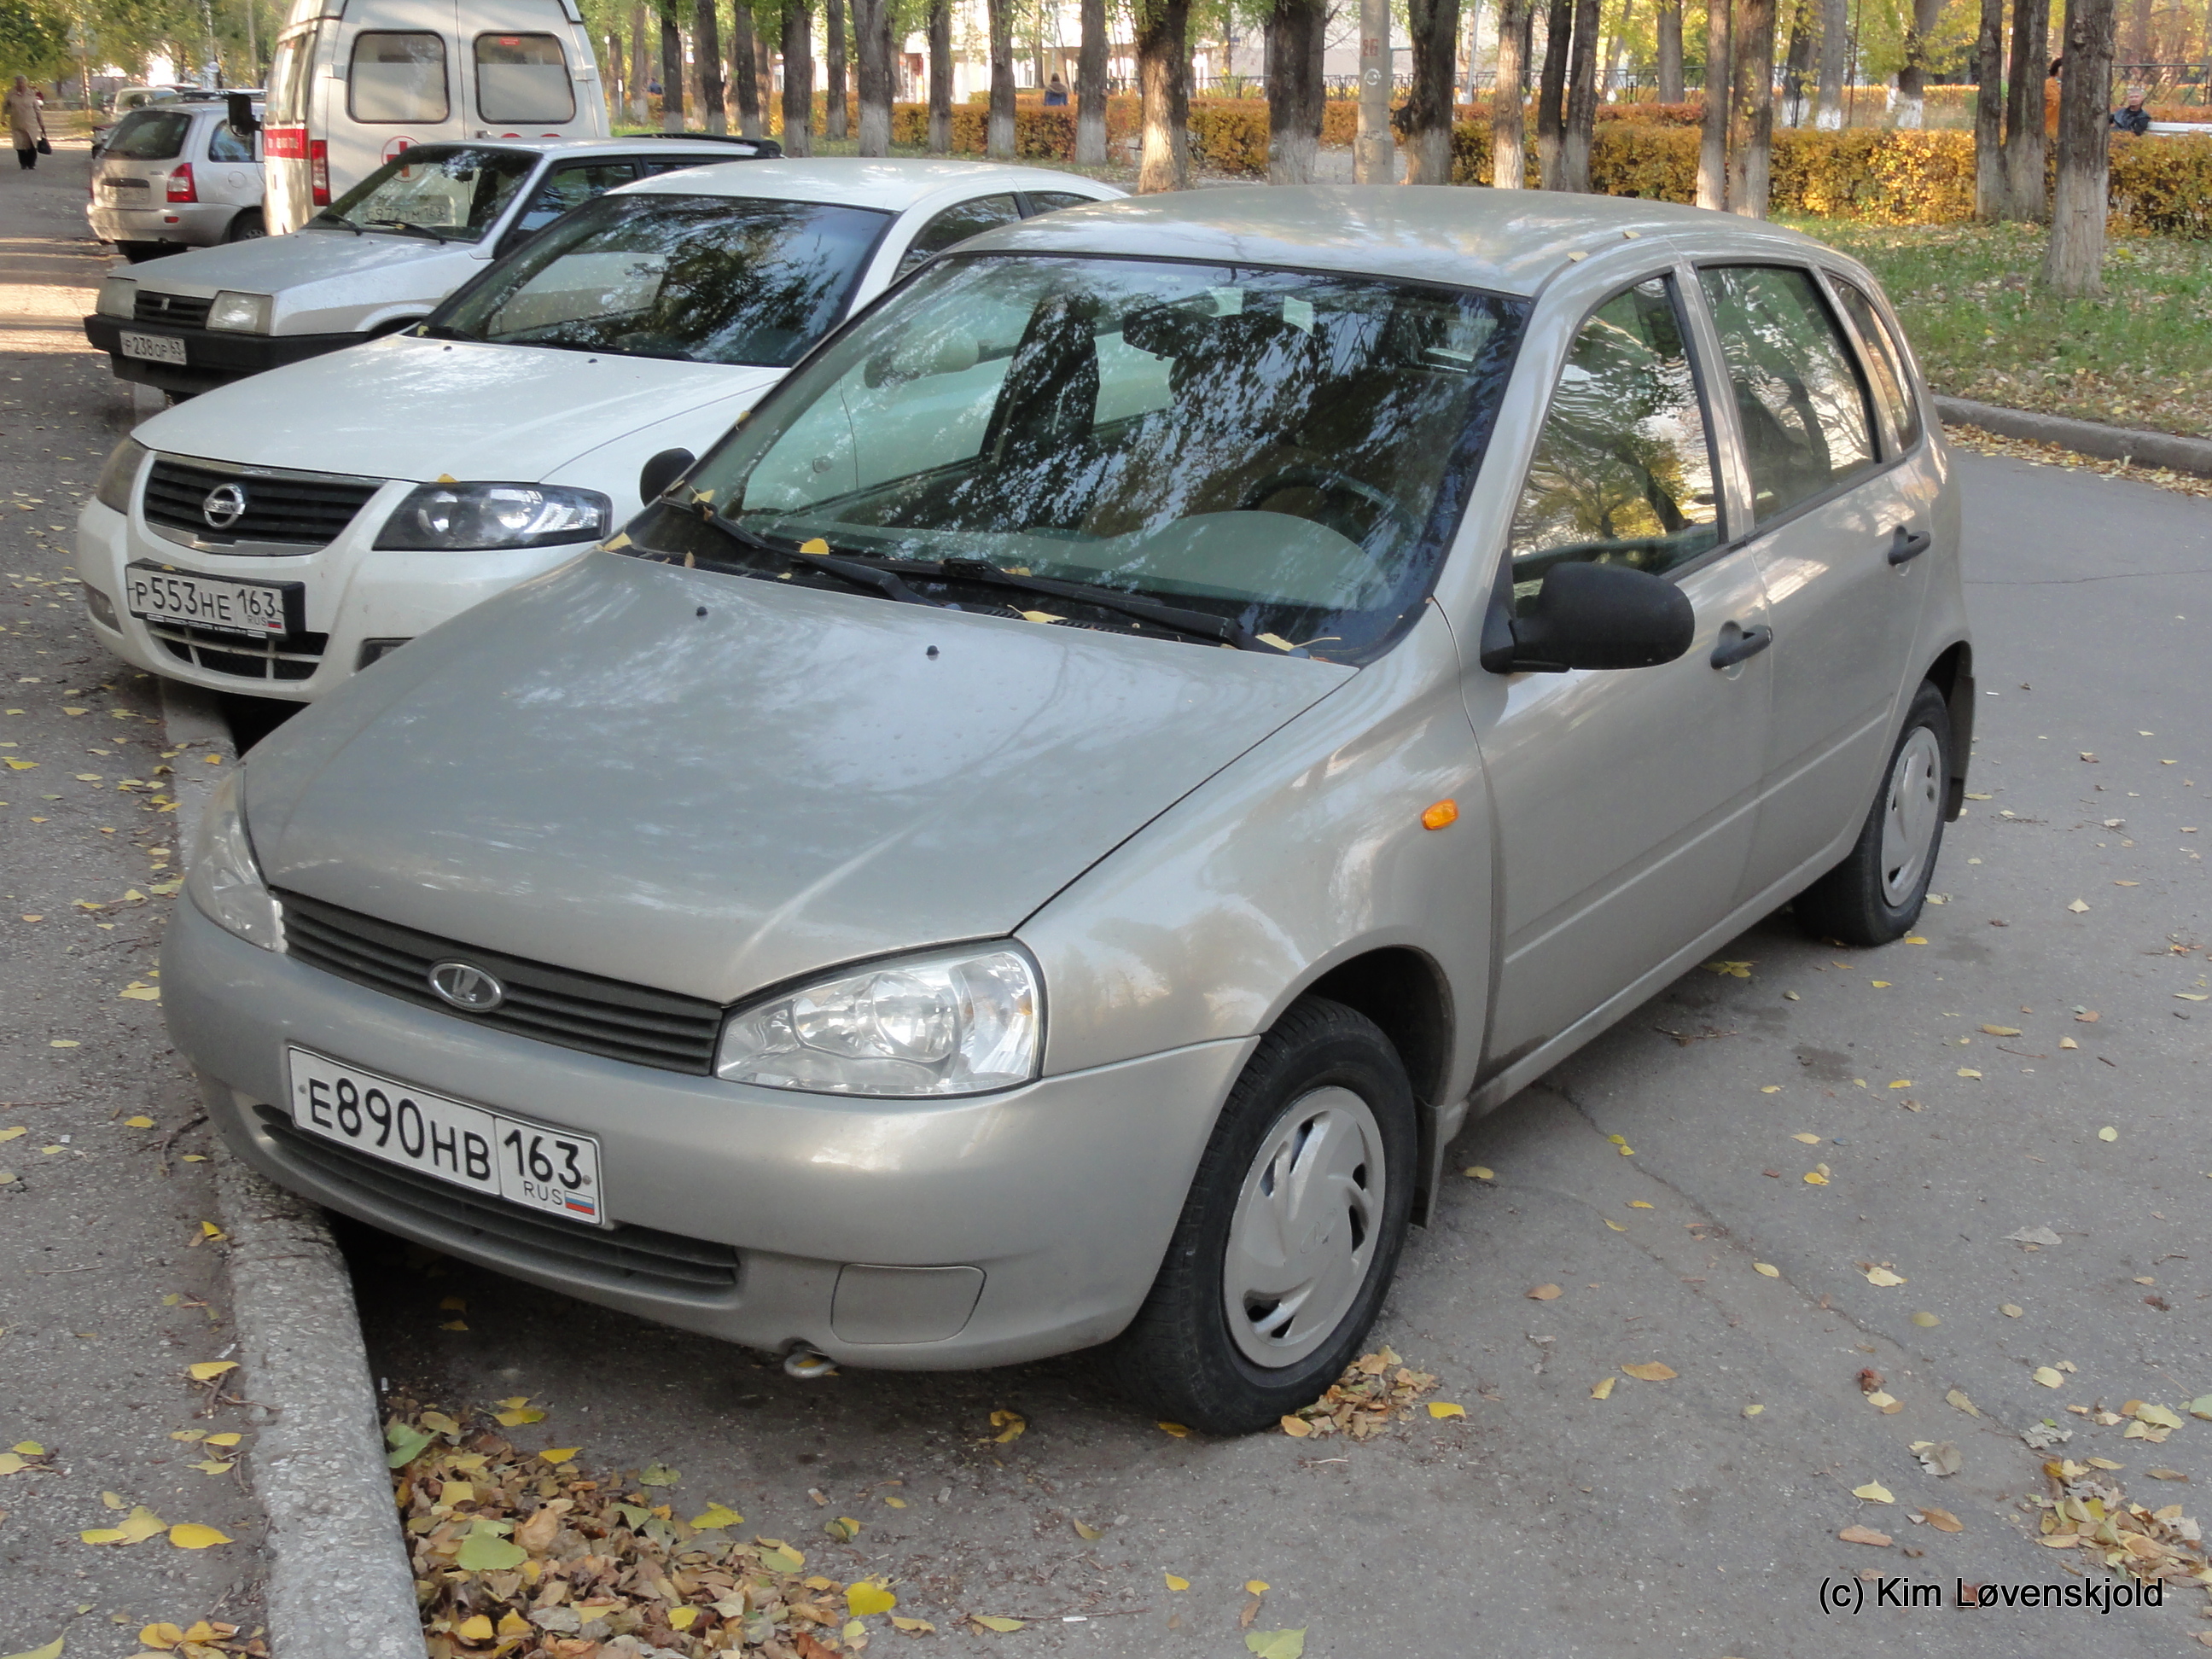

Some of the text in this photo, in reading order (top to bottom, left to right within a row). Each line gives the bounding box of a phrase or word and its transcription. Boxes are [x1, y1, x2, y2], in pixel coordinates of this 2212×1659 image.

[236, 588, 276, 618] 163
[247, 614, 268, 627] RUS
[504, 1128, 583, 1190] 163
[523, 1180, 564, 1206] RUS
